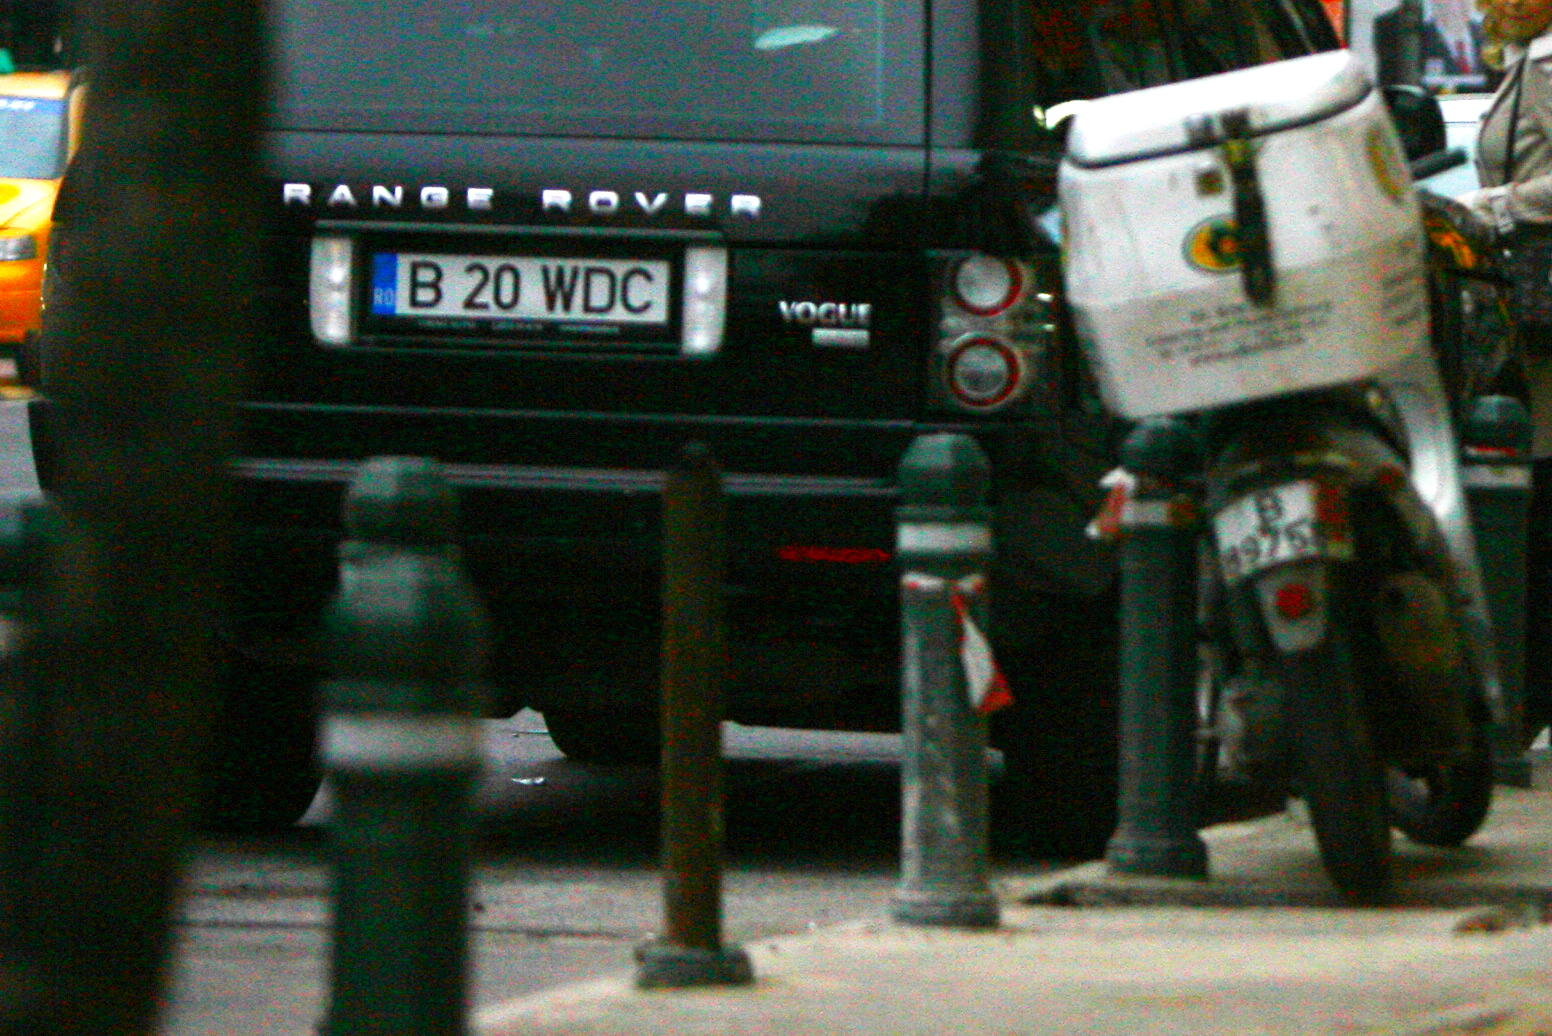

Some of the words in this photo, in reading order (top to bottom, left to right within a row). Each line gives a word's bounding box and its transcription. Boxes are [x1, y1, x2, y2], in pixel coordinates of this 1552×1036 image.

[283, 183, 495, 211] RANGE
[541, 189, 763, 216] ROVER
[462, 263, 521, 311] 20
[541, 265, 655, 315] WDC
[778, 300, 873, 325] VOGUE
